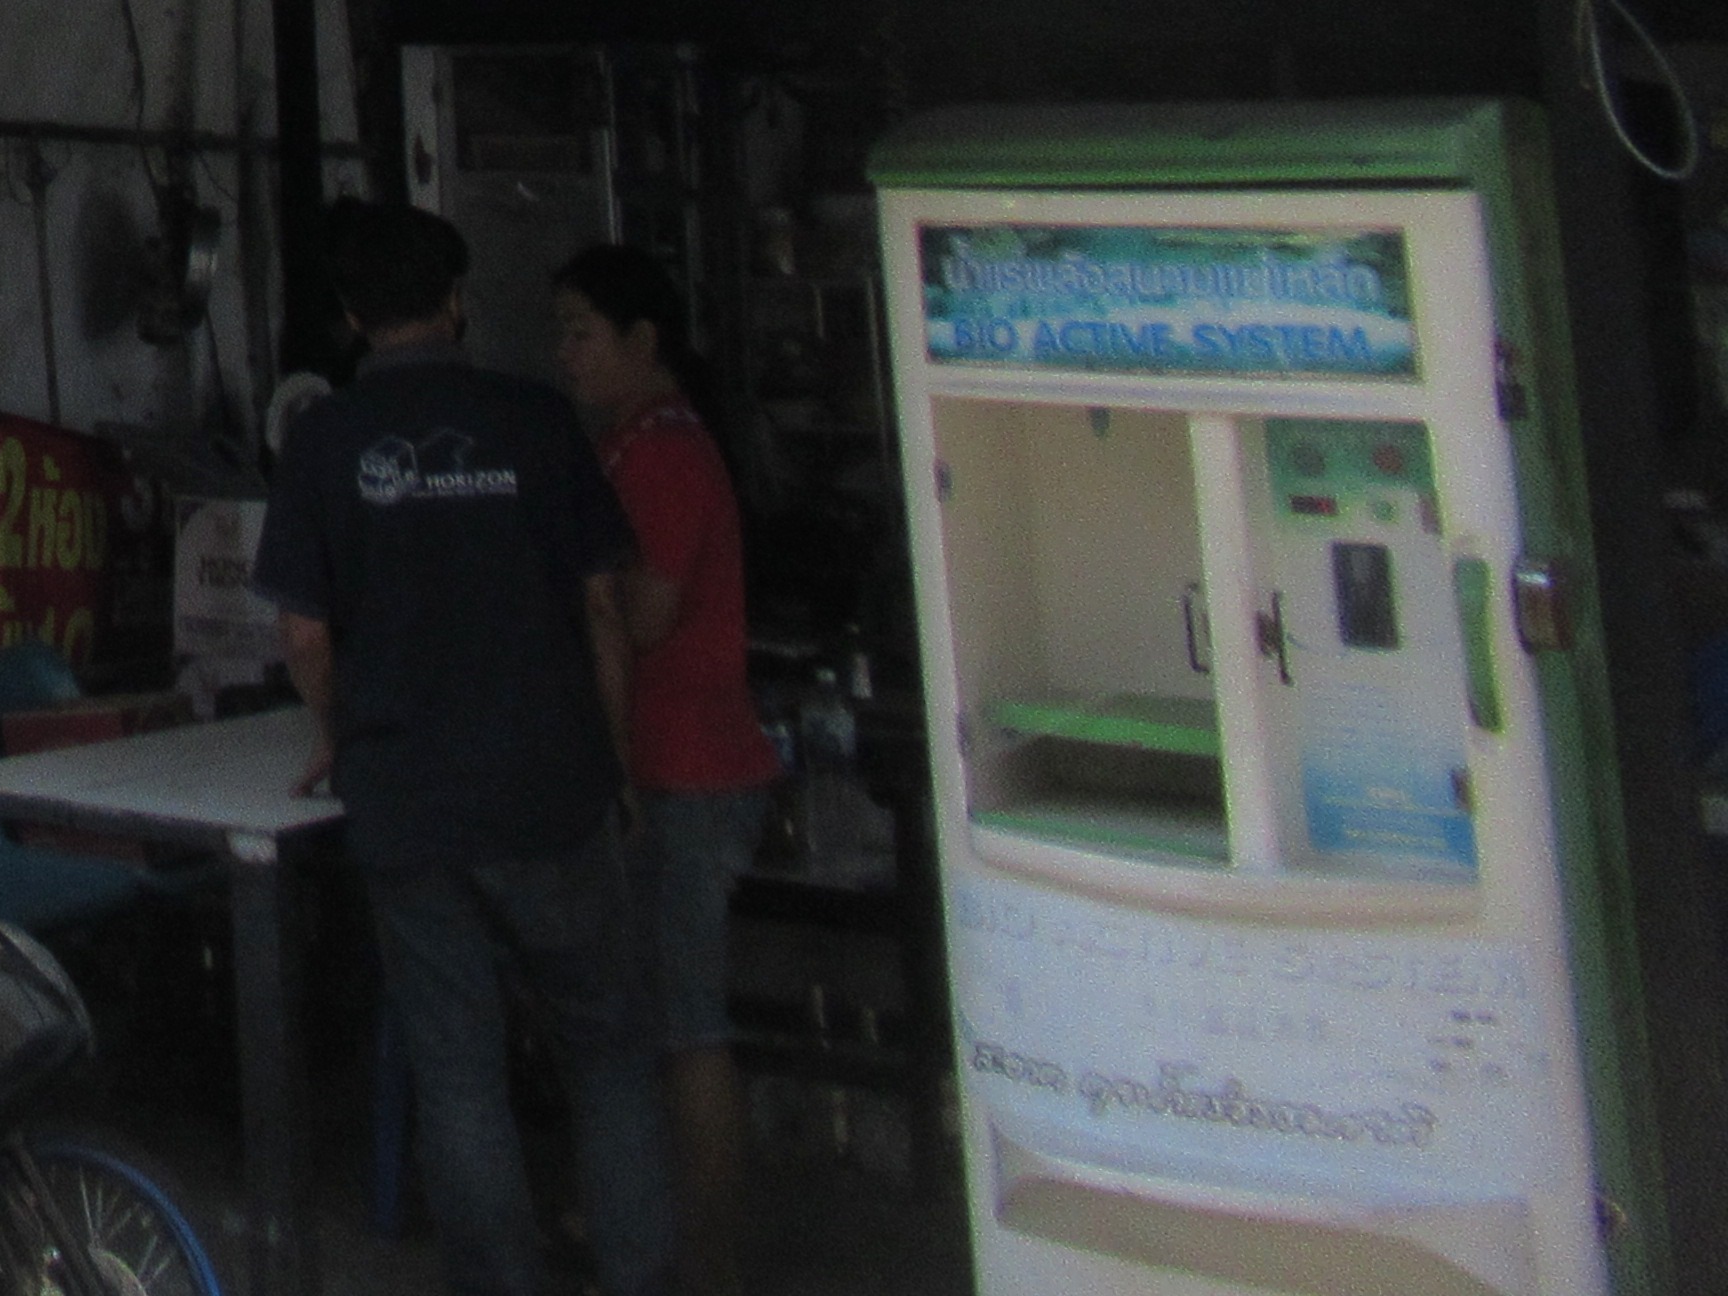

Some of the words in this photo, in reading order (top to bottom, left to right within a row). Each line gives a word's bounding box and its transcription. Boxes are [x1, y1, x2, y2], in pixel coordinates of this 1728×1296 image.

[951, 316, 1020, 353] BIO
[1031, 318, 1174, 358] ACTIVE
[1191, 321, 1374, 361] SYSTEM
